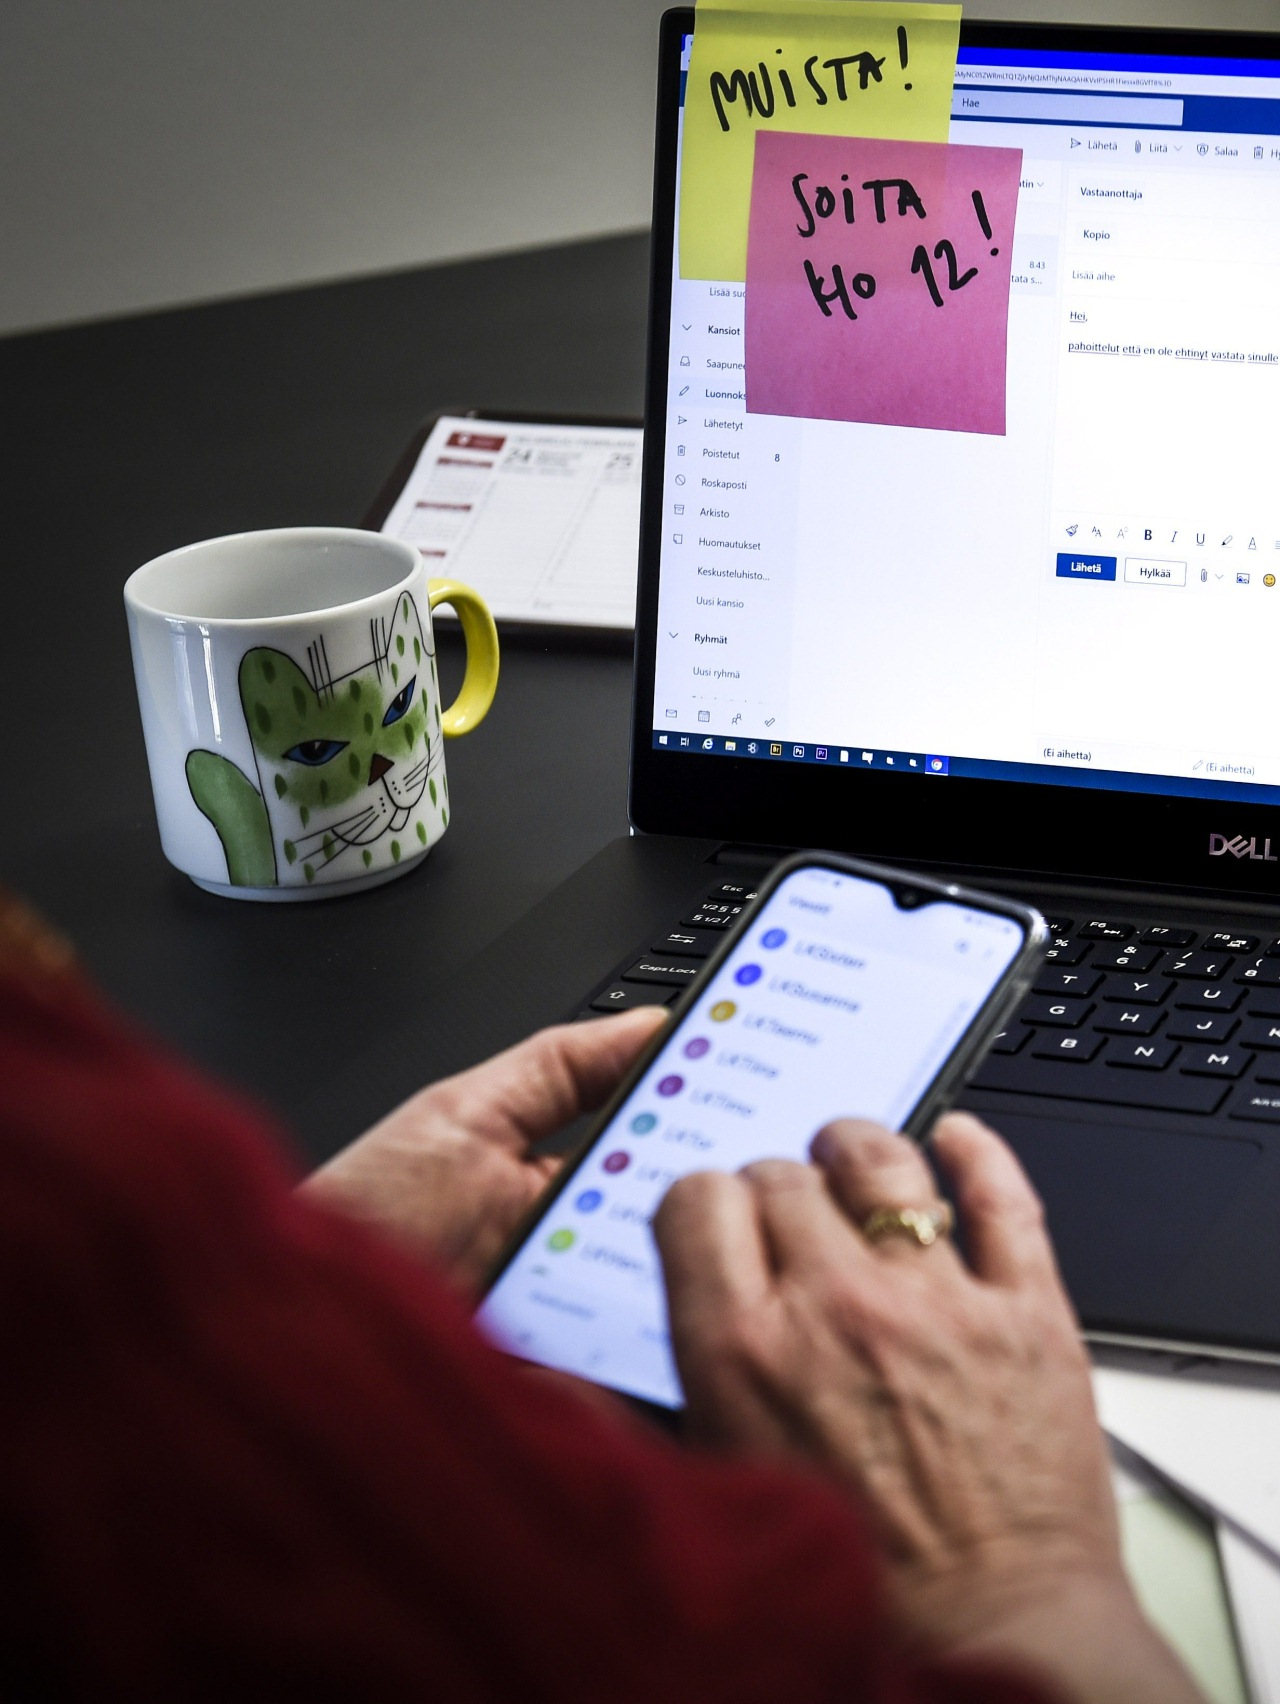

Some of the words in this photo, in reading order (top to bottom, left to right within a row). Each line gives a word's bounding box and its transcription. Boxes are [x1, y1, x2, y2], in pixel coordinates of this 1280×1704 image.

[962, 97, 980, 108] Hae
[1088, 140, 1118, 151] Lähetä
[1149, 142, 1168, 153] Liitä
[1214, 146, 1239, 157] Salaa
[1080, 187, 1143, 200] Vastaanottaja
[1083, 229, 1111, 241] Kopio
[911, 190, 999, 307] 12!
[1072, 270, 1094, 281] Lisää
[1097, 271, 1116, 282] aihe
[709, 287, 731, 297] Lisää
[1070, 311, 1088, 323] Hei,
[708, 325, 741, 336] Kansiot
[1068, 341, 1120, 354] pahoittelut
[1122, 345, 1141, 355] että
[1143, 347, 1155, 355] en
[1158, 347, 1173, 356] ole
[1175, 348, 1208, 360] ehtinyt
[1211, 351, 1245, 361] vastata
[1247, 352, 1279, 363] sinulle
[704, 418, 743, 431] Lähetetyt
[702, 449, 740, 460] Poistetut
[774, 454, 780, 462] 8
[701, 478, 747, 490] Roskaposti
[700, 508, 730, 519] Arkisto
[699, 537, 761, 550] Huomautukset
[1071, 561, 1101, 574] Lähetä
[1140, 567, 1171, 579] Hylkää
[697, 567, 770, 581] Keskusteluhisto...
[696, 596, 715, 606] Uusi
[717, 597, 744, 608] kansio
[694, 633, 728, 645] Ryhmät
[693, 666, 712, 677] Uusi
[714, 669, 740, 680] ryhmä
[1043, 747, 1055, 759] (Ei
[1057, 749, 1092, 762] aihetta)
[1206, 761, 1217, 773] (Ei
[1219, 763, 1255, 776] aihetta)
[1209, 833, 1278, 861] DELL
[1046, 950, 1059, 958] 5
[640, 964, 668, 972] Caps
[1173, 962, 1186, 970] 7
[1063, 975, 1078, 984] T
[1133, 982, 1149, 991] Y
[1204, 990, 1221, 999] U
[1049, 1006, 1066, 1015] G
[1120, 1013, 1140, 1023] H
[1197, 1021, 1212, 1030] J
[1060, 1038, 1078, 1049] B
[1134, 1046, 1155, 1057] N
[1207, 1054, 1230, 1065] M
